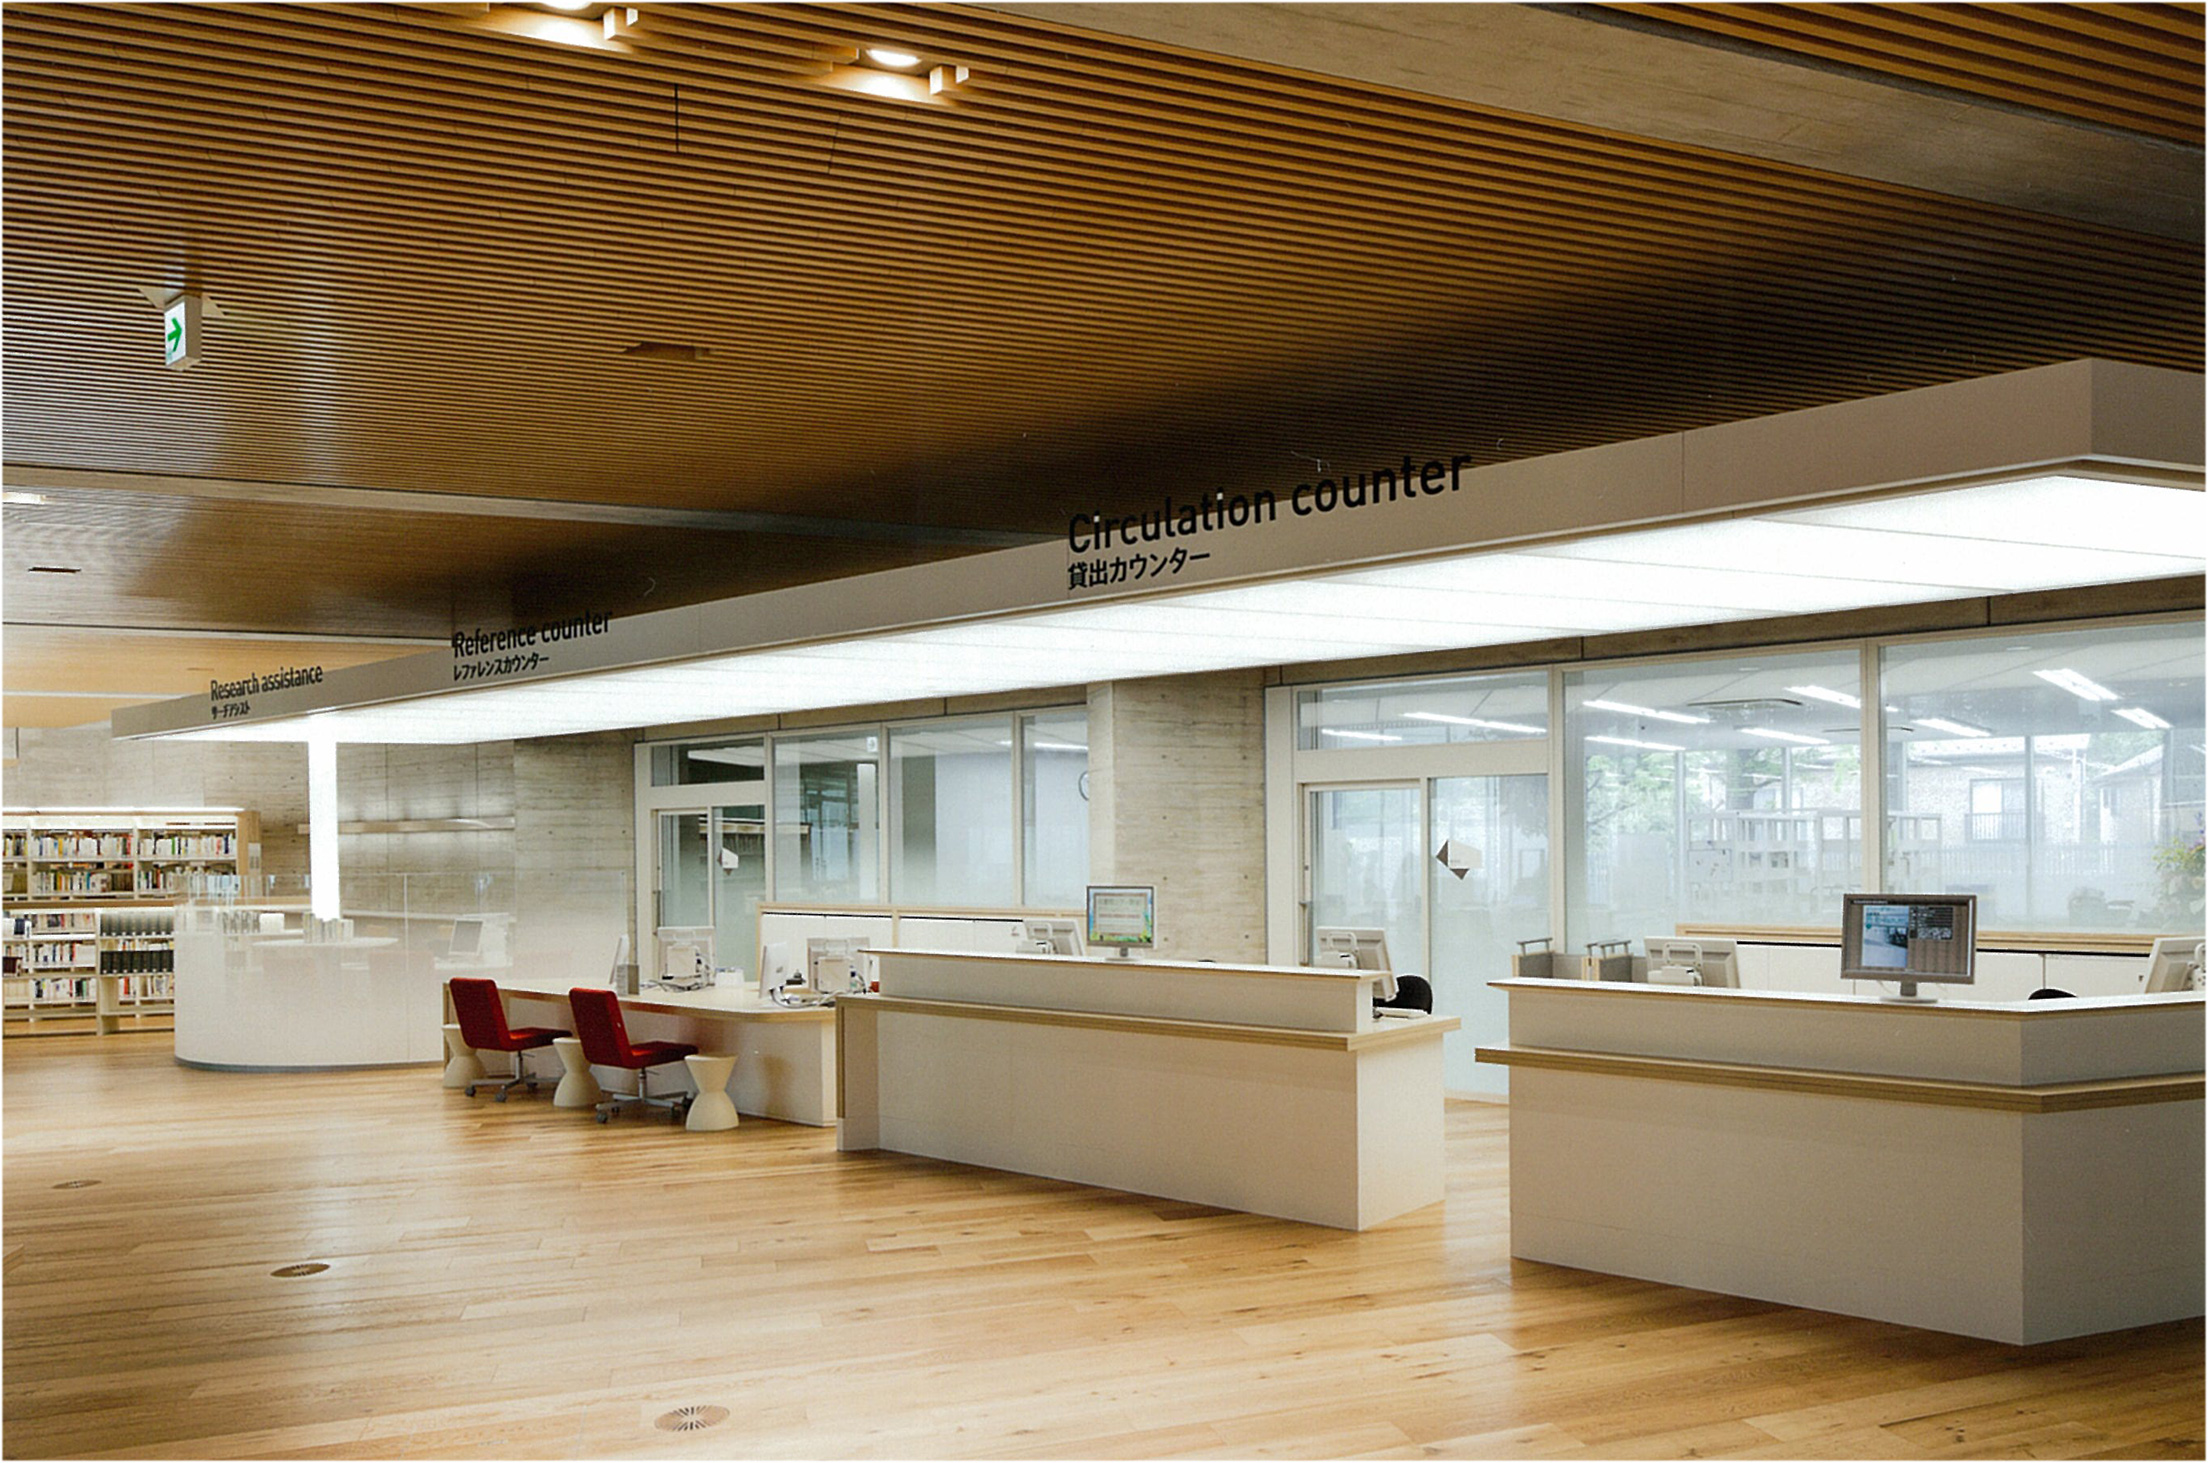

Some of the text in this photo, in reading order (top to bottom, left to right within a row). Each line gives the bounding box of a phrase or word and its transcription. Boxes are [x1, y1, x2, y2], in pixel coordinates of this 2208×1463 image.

[1068, 454, 1472, 554] Circulation counter
[1067, 546, 1211, 591] 貸出カウンター
[453, 610, 613, 659] Reference counter
[210, 665, 323, 701] Research assistance
[453, 651, 550, 682] レファレンスカウンター
